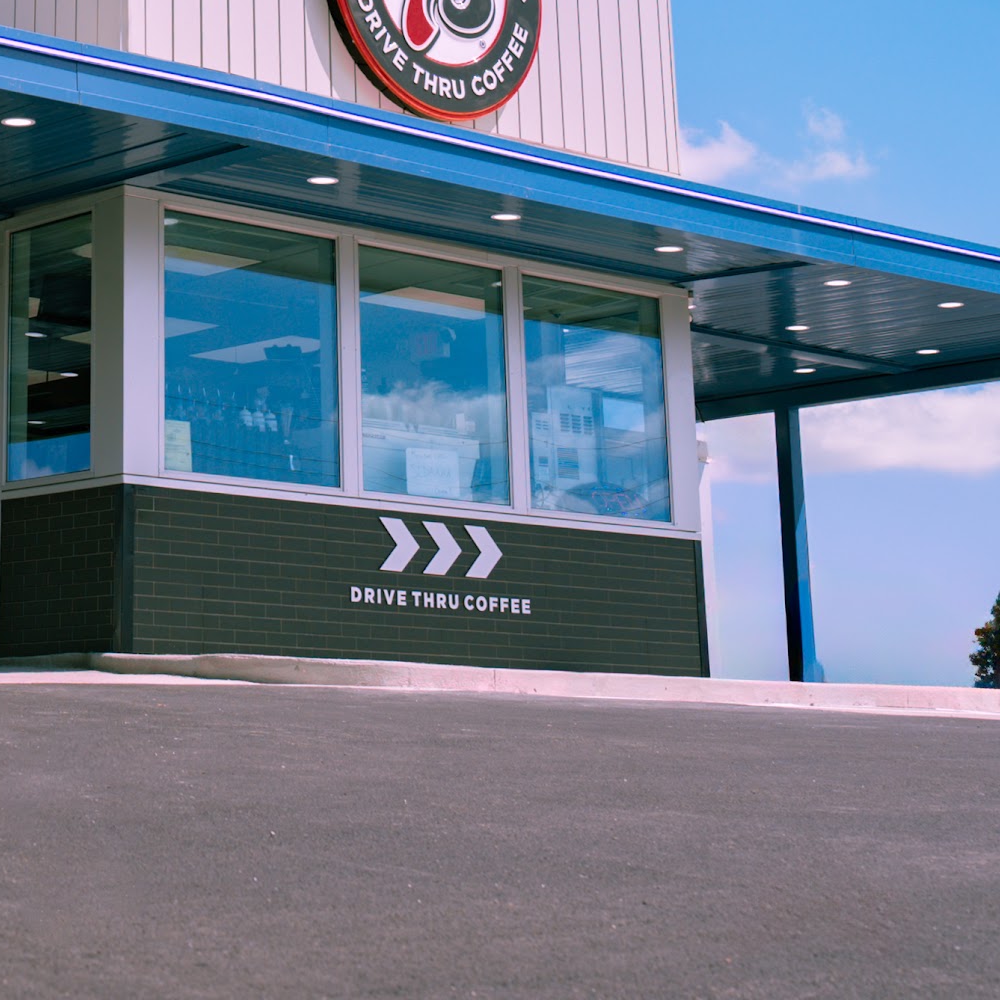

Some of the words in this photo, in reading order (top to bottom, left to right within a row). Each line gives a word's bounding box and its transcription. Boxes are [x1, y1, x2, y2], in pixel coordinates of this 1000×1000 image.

[412, 62, 467, 100] THRU
[470, 22, 530, 97] COFFEE
[350, 586, 407, 606] DRIVE
[412, 591, 460, 610] THRU
[464, 595, 532, 615] COFFEE
